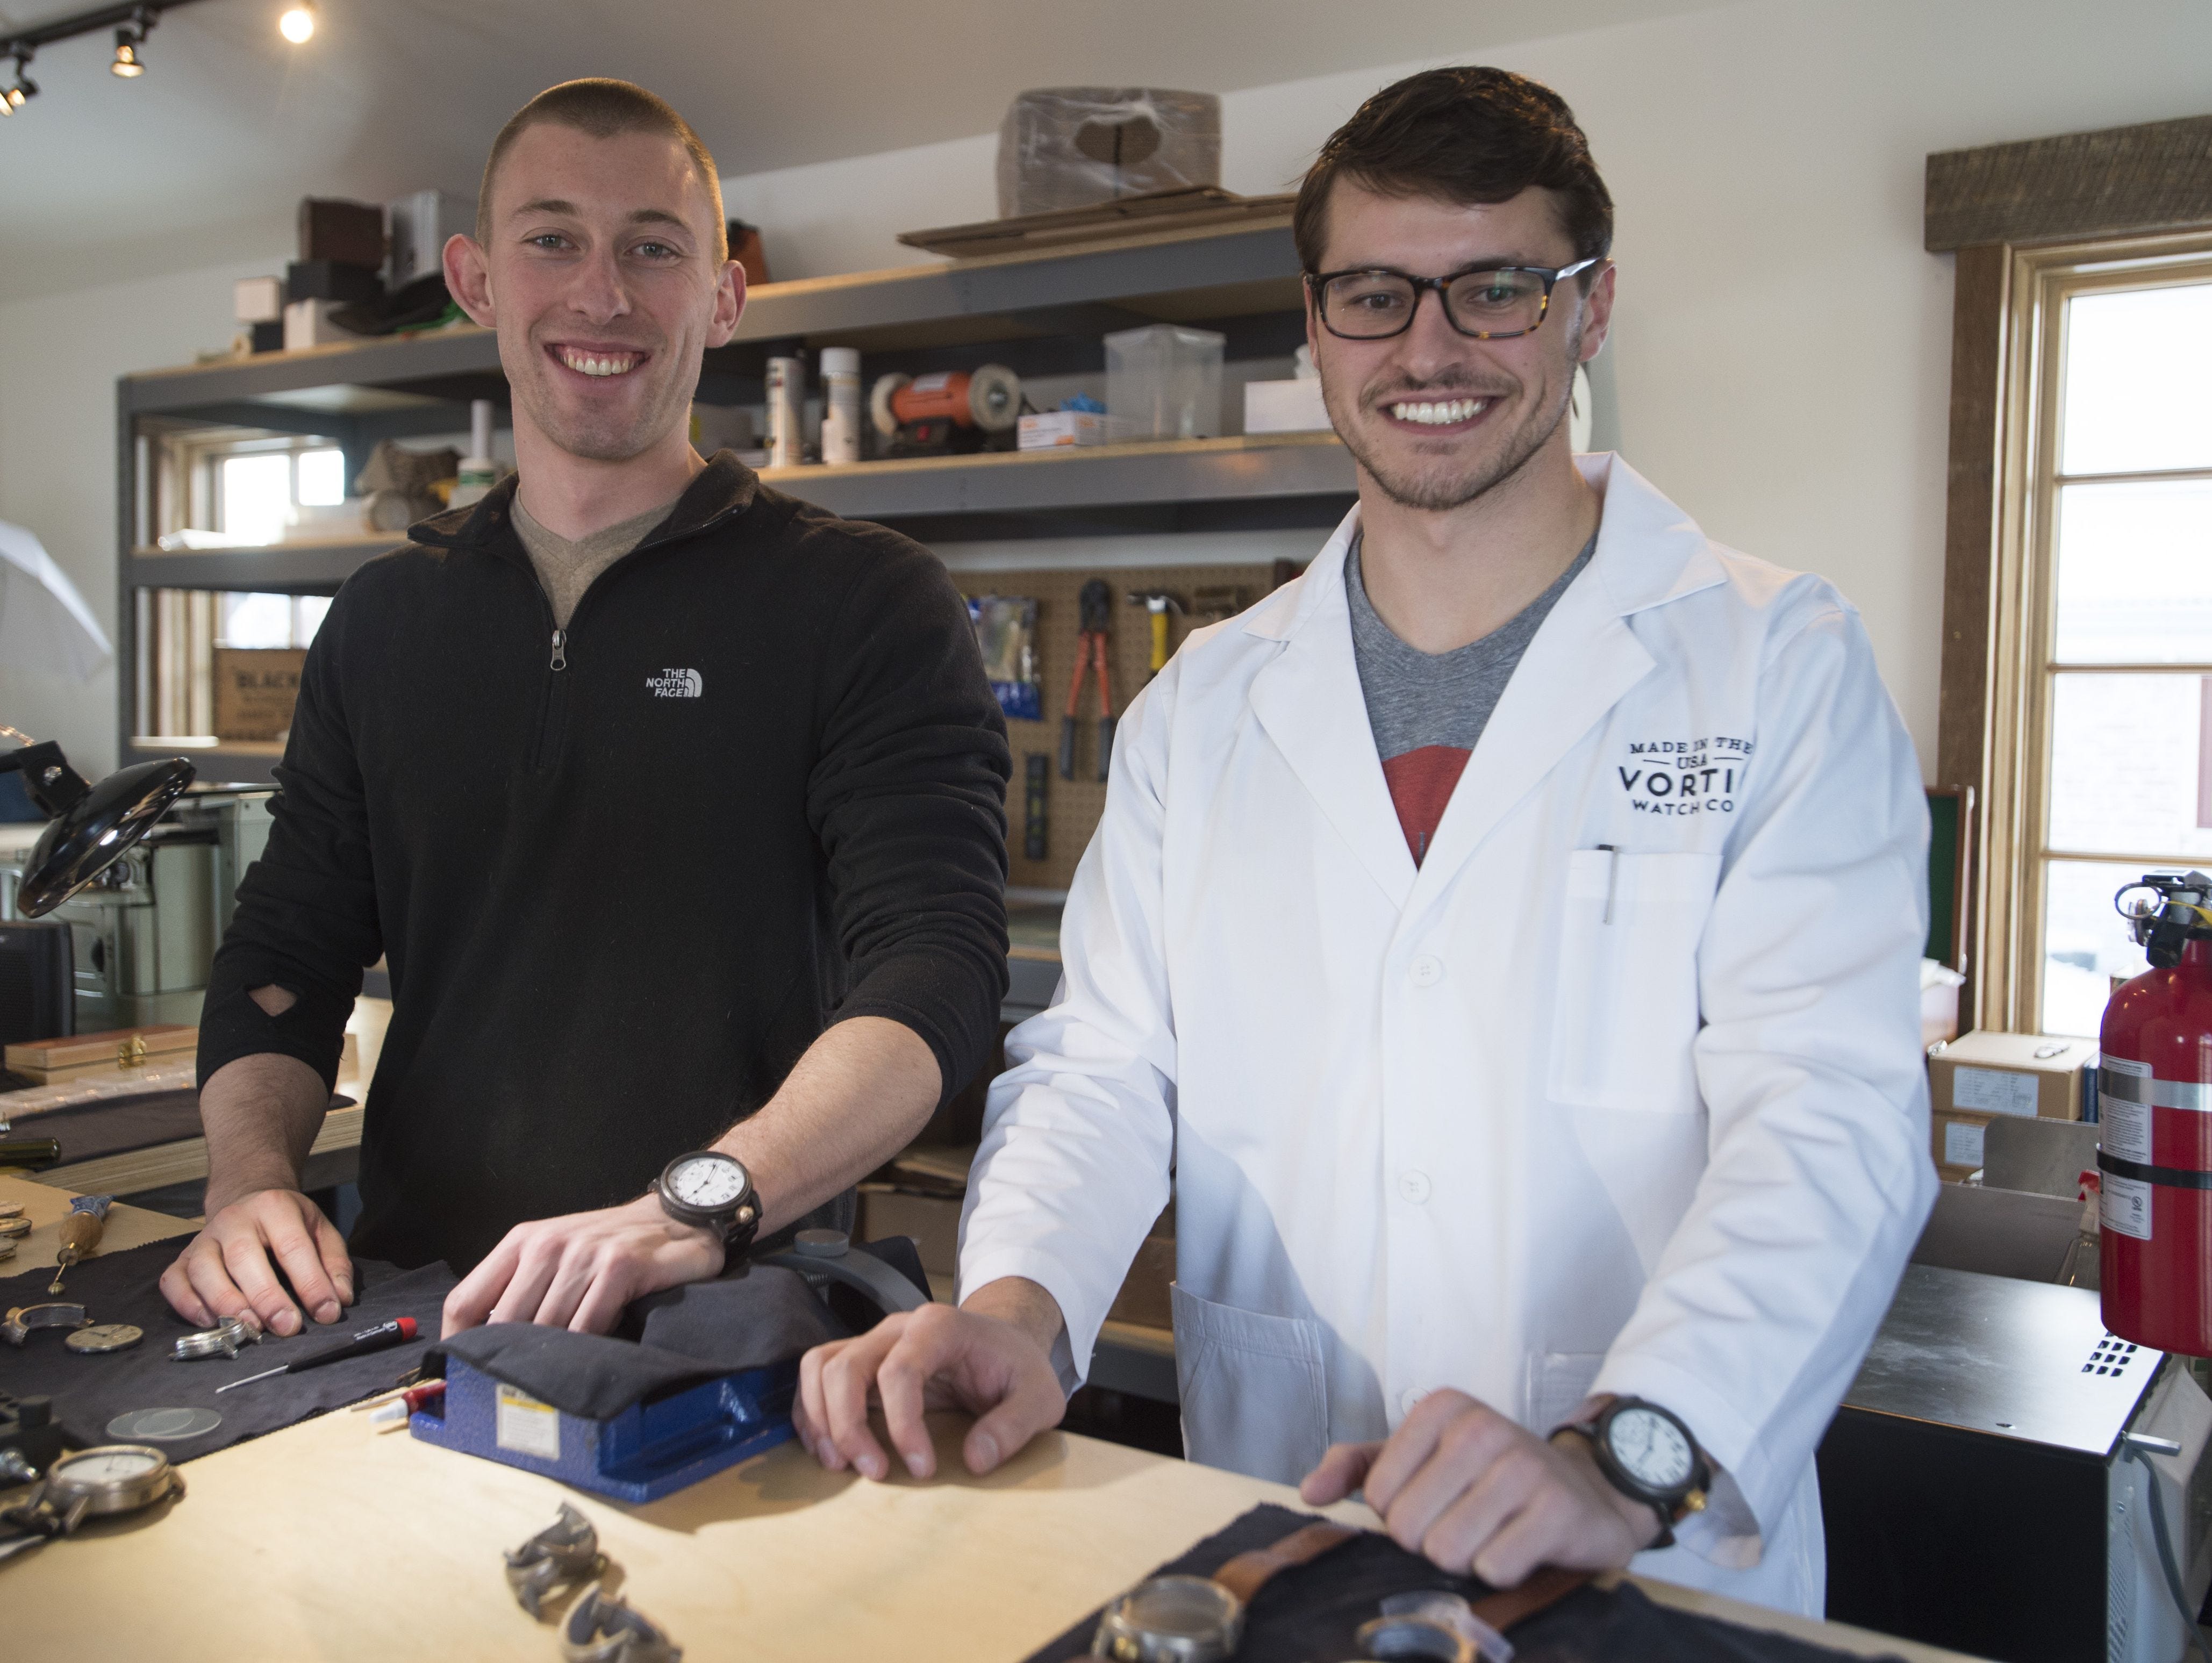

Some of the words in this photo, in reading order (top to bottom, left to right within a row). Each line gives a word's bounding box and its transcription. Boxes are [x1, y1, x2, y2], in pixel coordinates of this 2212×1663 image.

[663, 669, 685, 678] THE
[646, 678, 684, 687] NORTH
[654, 688, 684, 697] FACE
[1630, 742, 1688, 754] MADE
[1693, 738, 1708, 751] IN
[1715, 737, 1753, 754] THE
[1678, 754, 1708, 770] USA
[1619, 766, 1733, 797] VORTI
[1632, 799, 1699, 815] WATCH
